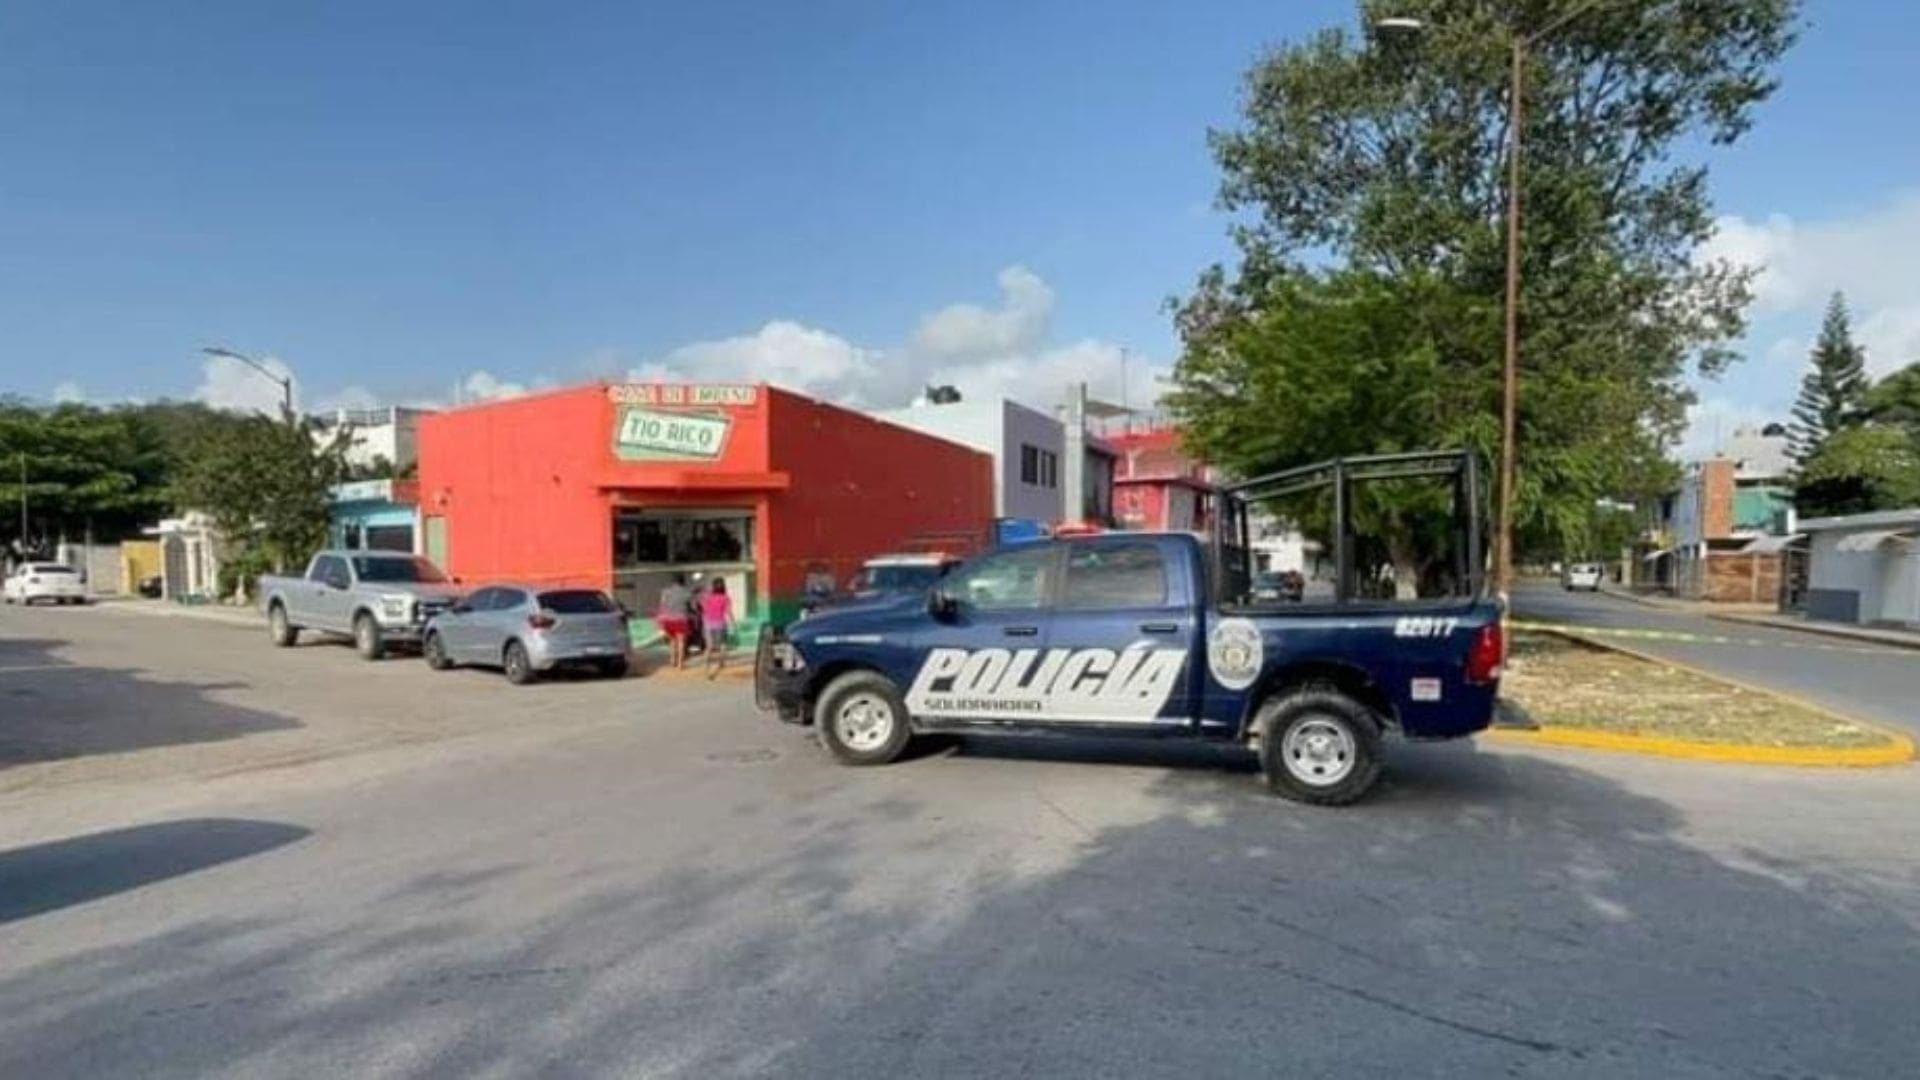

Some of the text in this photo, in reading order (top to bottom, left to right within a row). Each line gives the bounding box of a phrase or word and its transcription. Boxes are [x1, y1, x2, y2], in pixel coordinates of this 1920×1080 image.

[630, 417, 713, 446] TIO RICO
[908, 639, 1189, 700] POLICÍA
